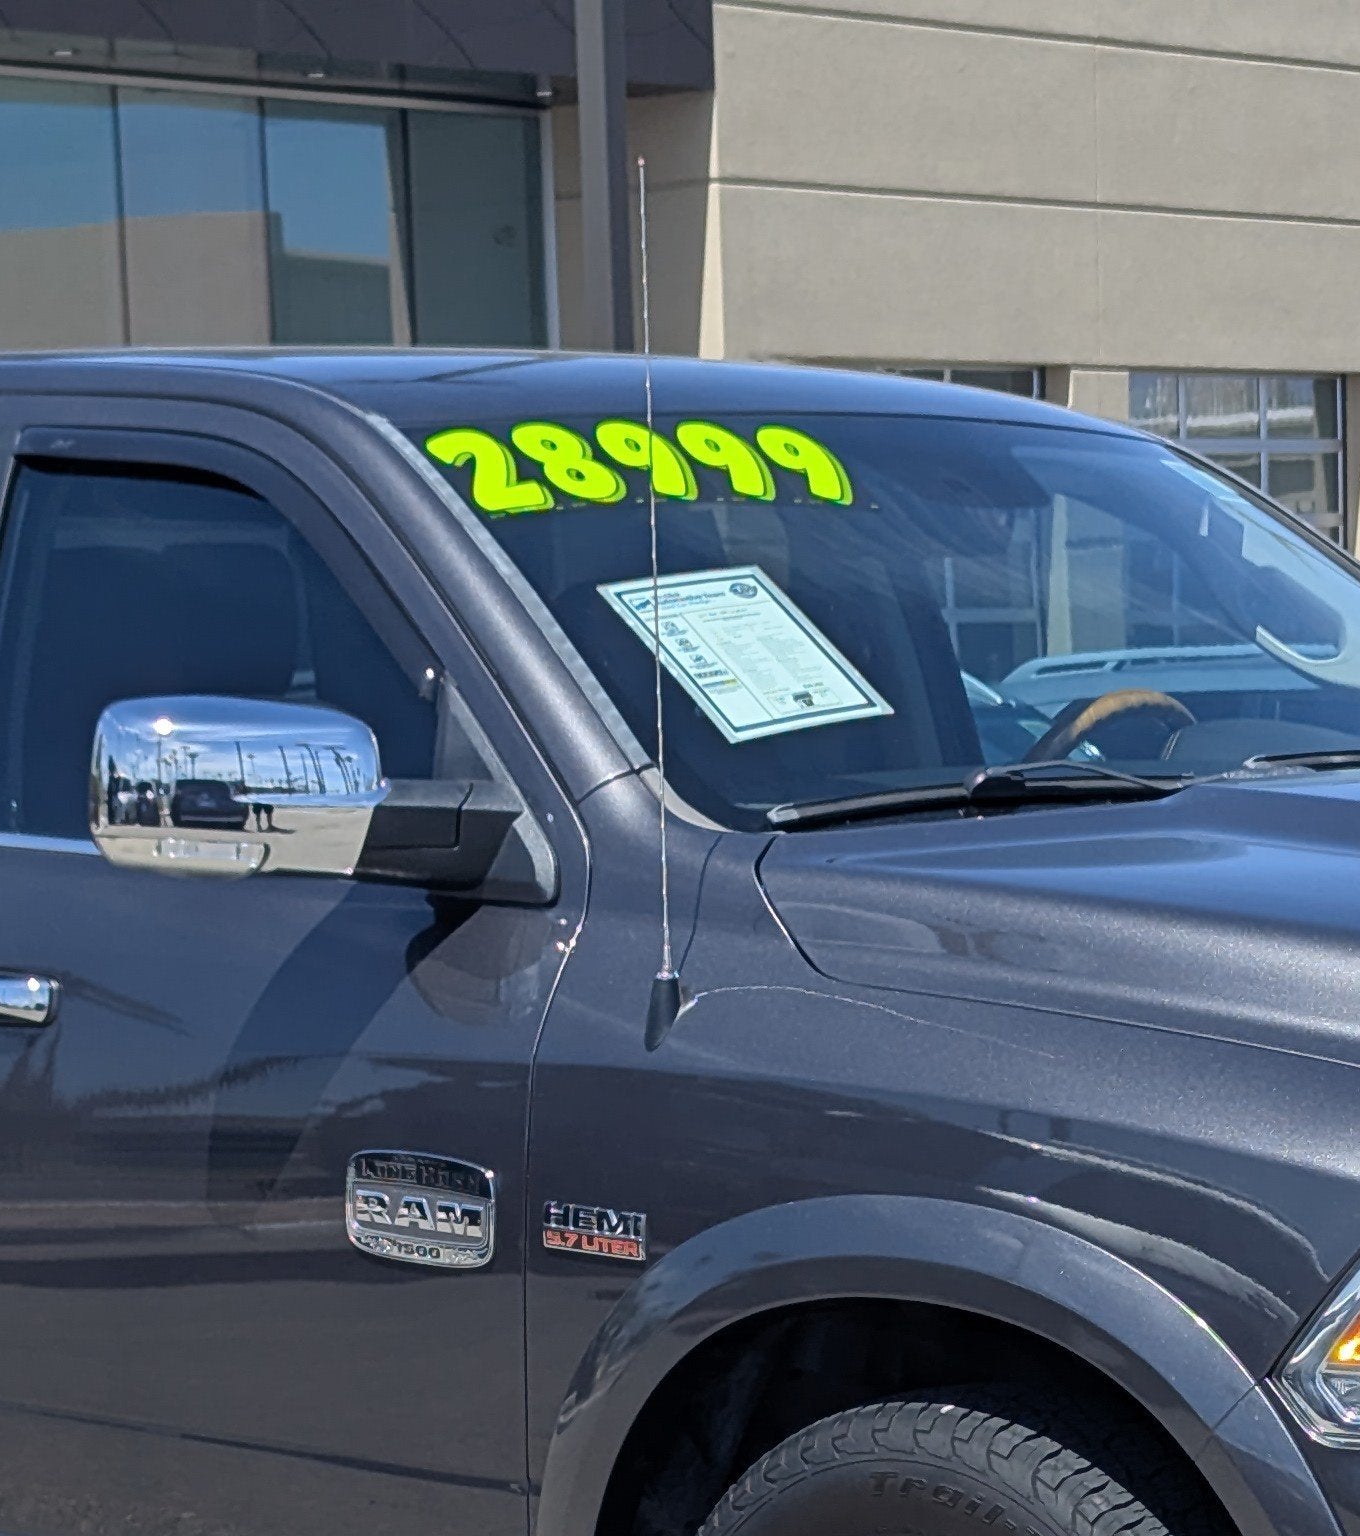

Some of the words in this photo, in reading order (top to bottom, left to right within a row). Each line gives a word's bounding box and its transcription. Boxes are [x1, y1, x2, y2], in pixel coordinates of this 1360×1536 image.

[425, 420, 854, 514] 28999
[355, 1189, 484, 1238] RAM
[543, 1200, 646, 1240] HEMI
[546, 1230, 578, 1248] 5.7
